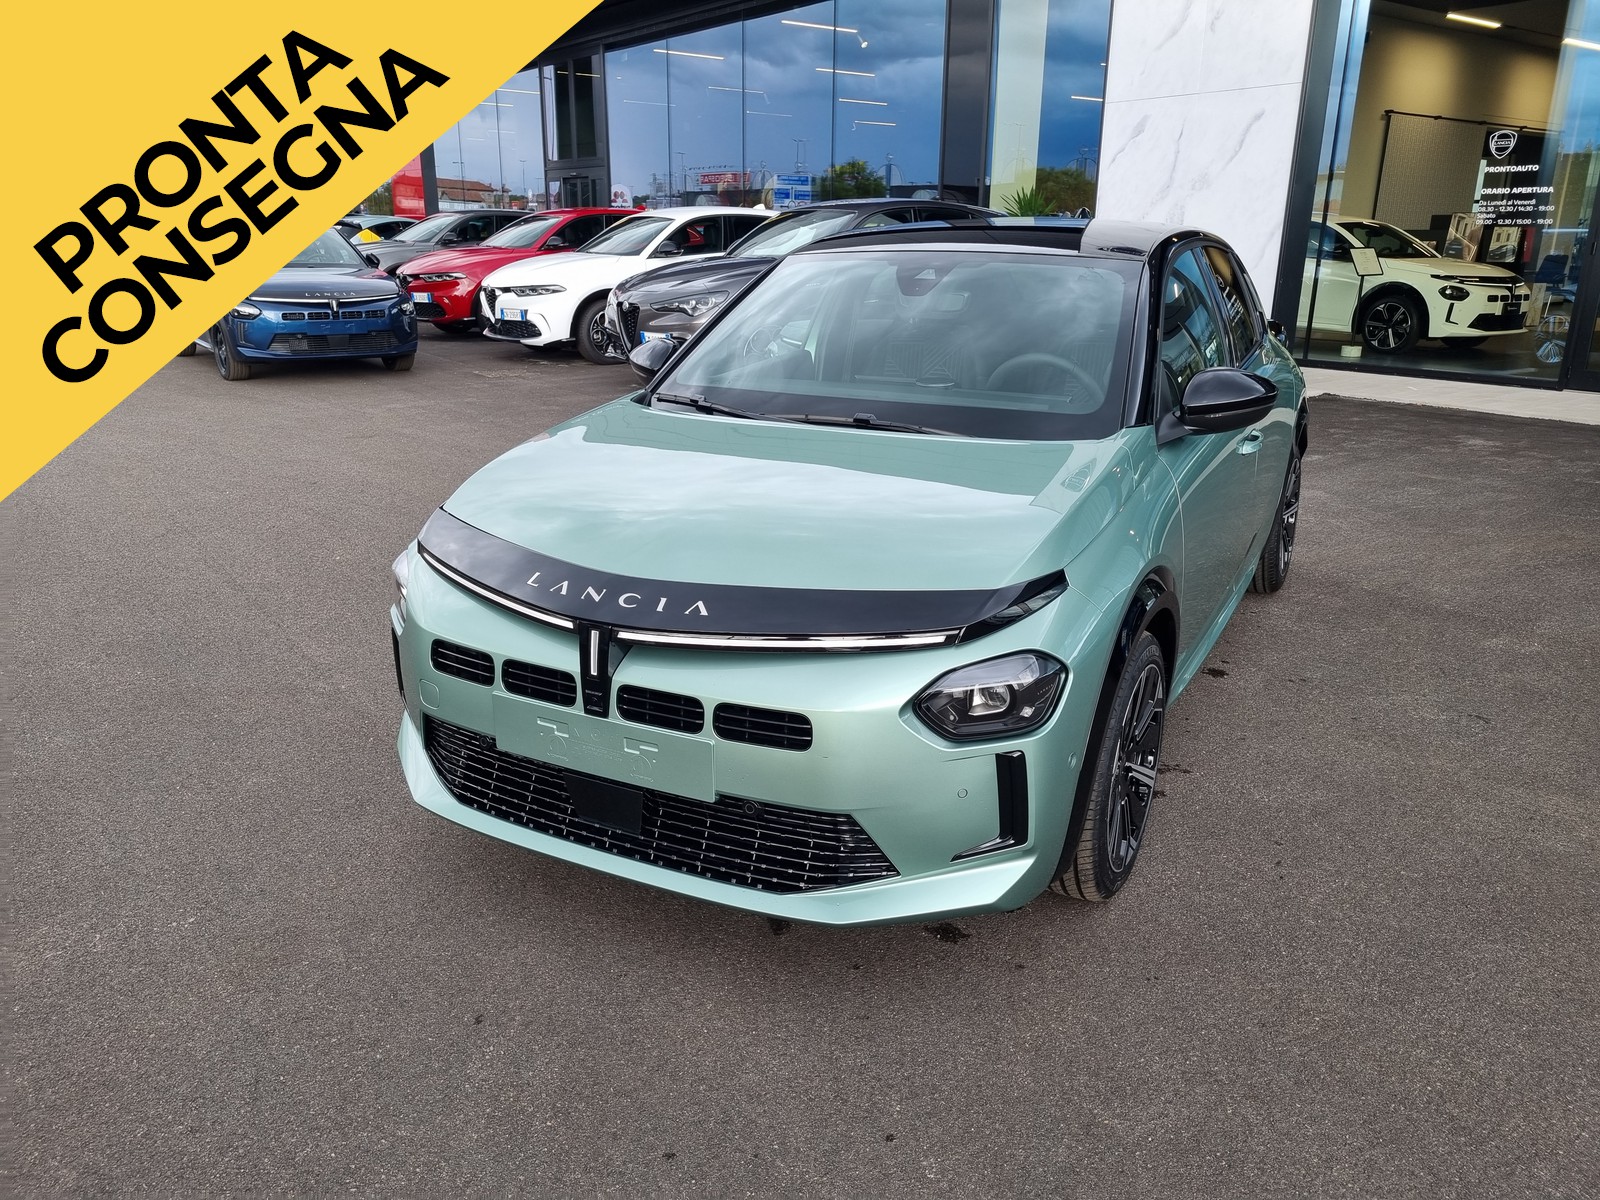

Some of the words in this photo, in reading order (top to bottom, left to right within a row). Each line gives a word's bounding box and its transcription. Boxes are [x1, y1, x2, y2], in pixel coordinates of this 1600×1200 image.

[1484, 164, 1540, 173] PRONTOAUTO
[1480, 187, 1511, 195] ORARIO
[1511, 186, 1554, 194] APERTURA
[526, 571, 709, 616] LANCIA
